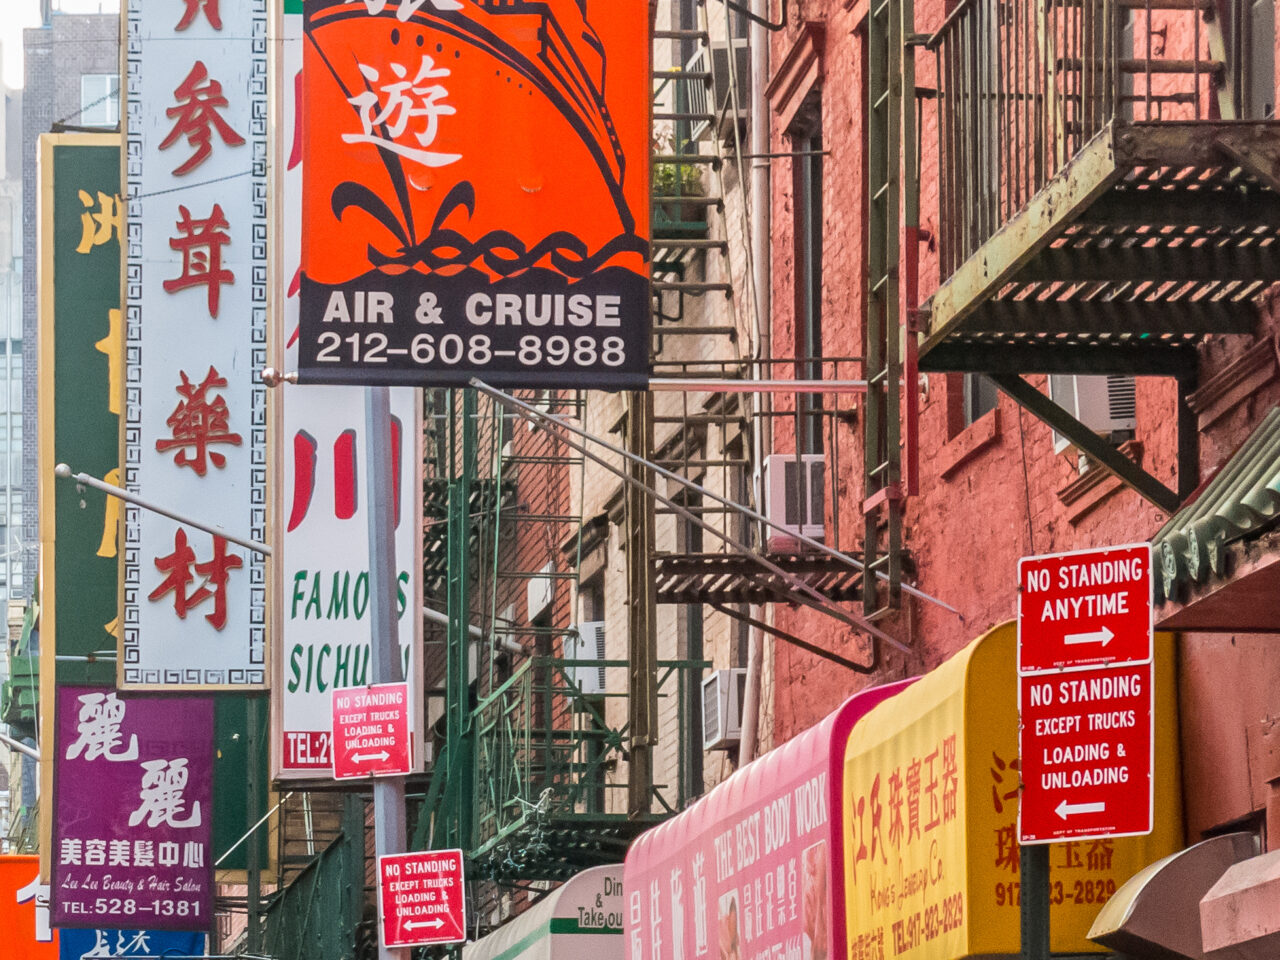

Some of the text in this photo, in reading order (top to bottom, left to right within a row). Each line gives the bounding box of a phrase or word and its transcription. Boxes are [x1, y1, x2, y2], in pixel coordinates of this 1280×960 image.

[322, 291, 621, 327] AIR & CRUISE
[316, 332, 626, 367] 212-608-8988
[1027, 557, 1142, 593] NO STANDING
[291, 569, 410, 621] FAMOS
[1041, 592, 1129, 622] ANYTIME
[288, 643, 410, 693] SICHU
[337, 692, 403, 709] NO STANDING
[1030, 674, 1141, 706] NO STANDING
[339, 710, 400, 724] EXCEPT TRUCKS
[1035, 710, 1135, 736] EXCEPT TRUCKS
[344, 724, 395, 736] LOADING &
[345, 737, 396, 749] UNLOADING
[1043, 743, 1126, 765] LOADING &
[1042, 767, 1128, 790] UNLOADING
[714, 771, 828, 883] THE BEST BODY WORK
[61, 839, 204, 868] 美容美髮中心
[994, 823, 1114, 874] 珠玉器
[385, 859, 457, 877] NO STANDING
[62, 873, 201, 894] Lee Lee Beauty & Hair Salon
[389, 877, 454, 892] EXCEPT TRUCKS
[394, 891, 448, 904] LOADING &
[595, 893, 603, 908] &
[396, 904, 449, 917] UNLOADING
